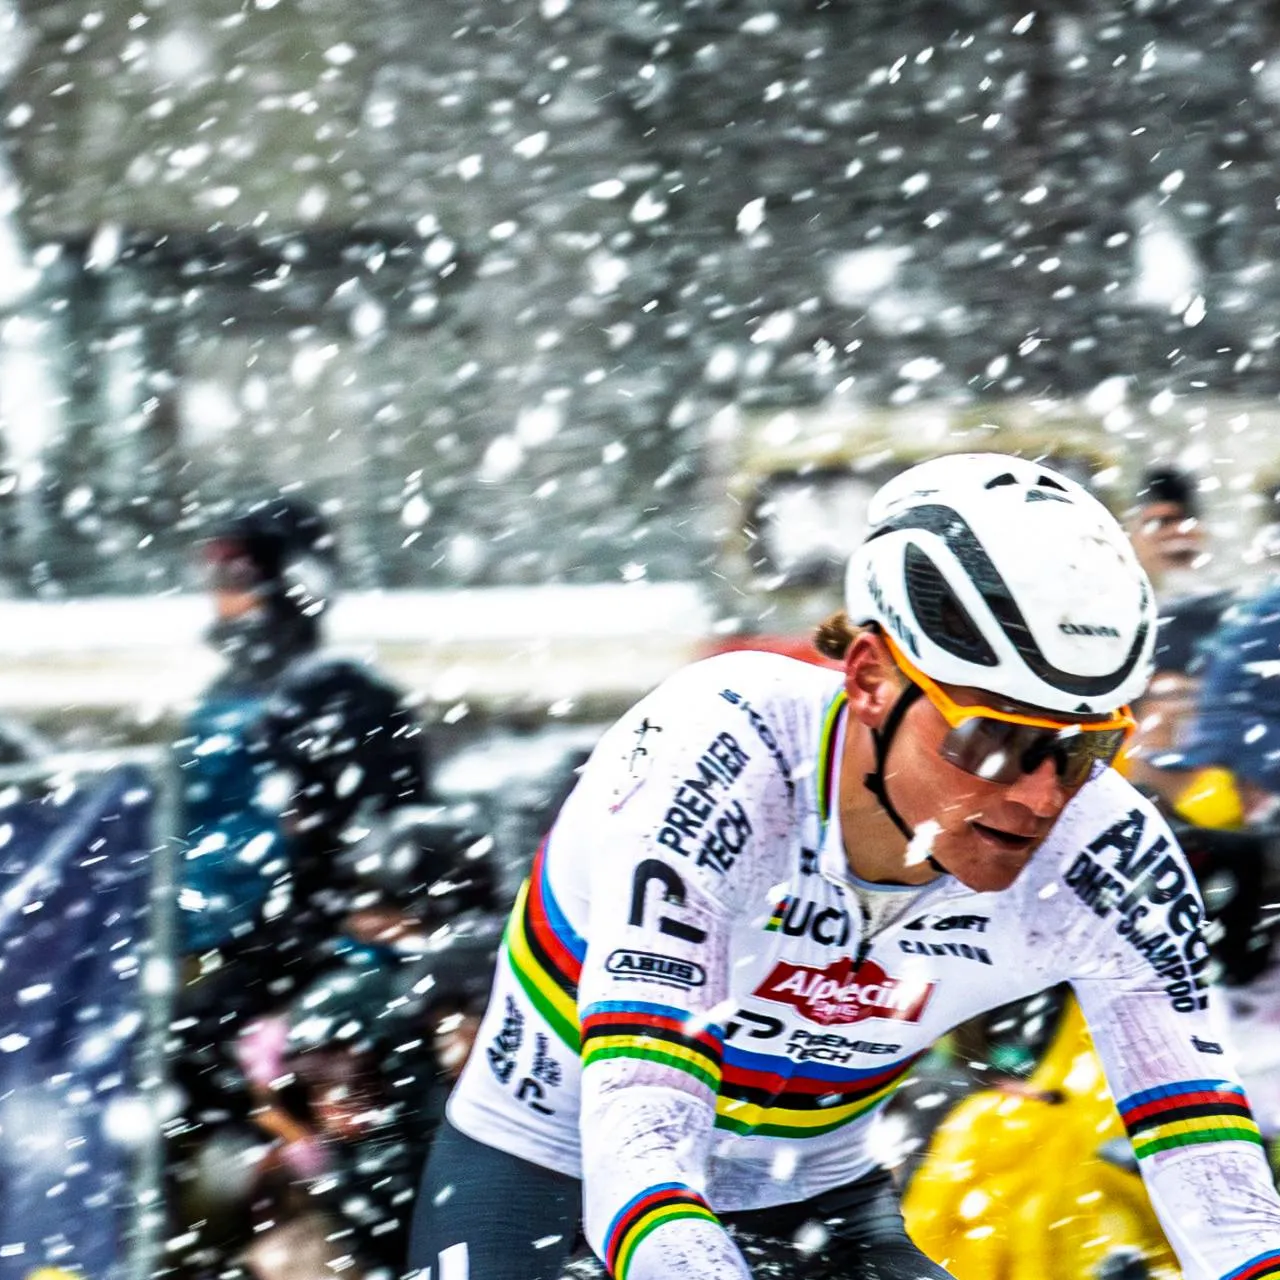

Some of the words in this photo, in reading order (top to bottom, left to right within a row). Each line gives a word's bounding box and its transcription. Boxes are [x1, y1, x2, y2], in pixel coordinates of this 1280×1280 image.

[657, 731, 751, 857] PREMIER
[696, 799, 753, 875] TECH
[782, 897, 849, 947] UCI
[615, 955, 694, 980] ABUS
[1116, 904, 1196, 1012] SAMPOO
[785, 1043, 852, 1063] TECH
[789, 1029, 902, 1054] PREMIER
